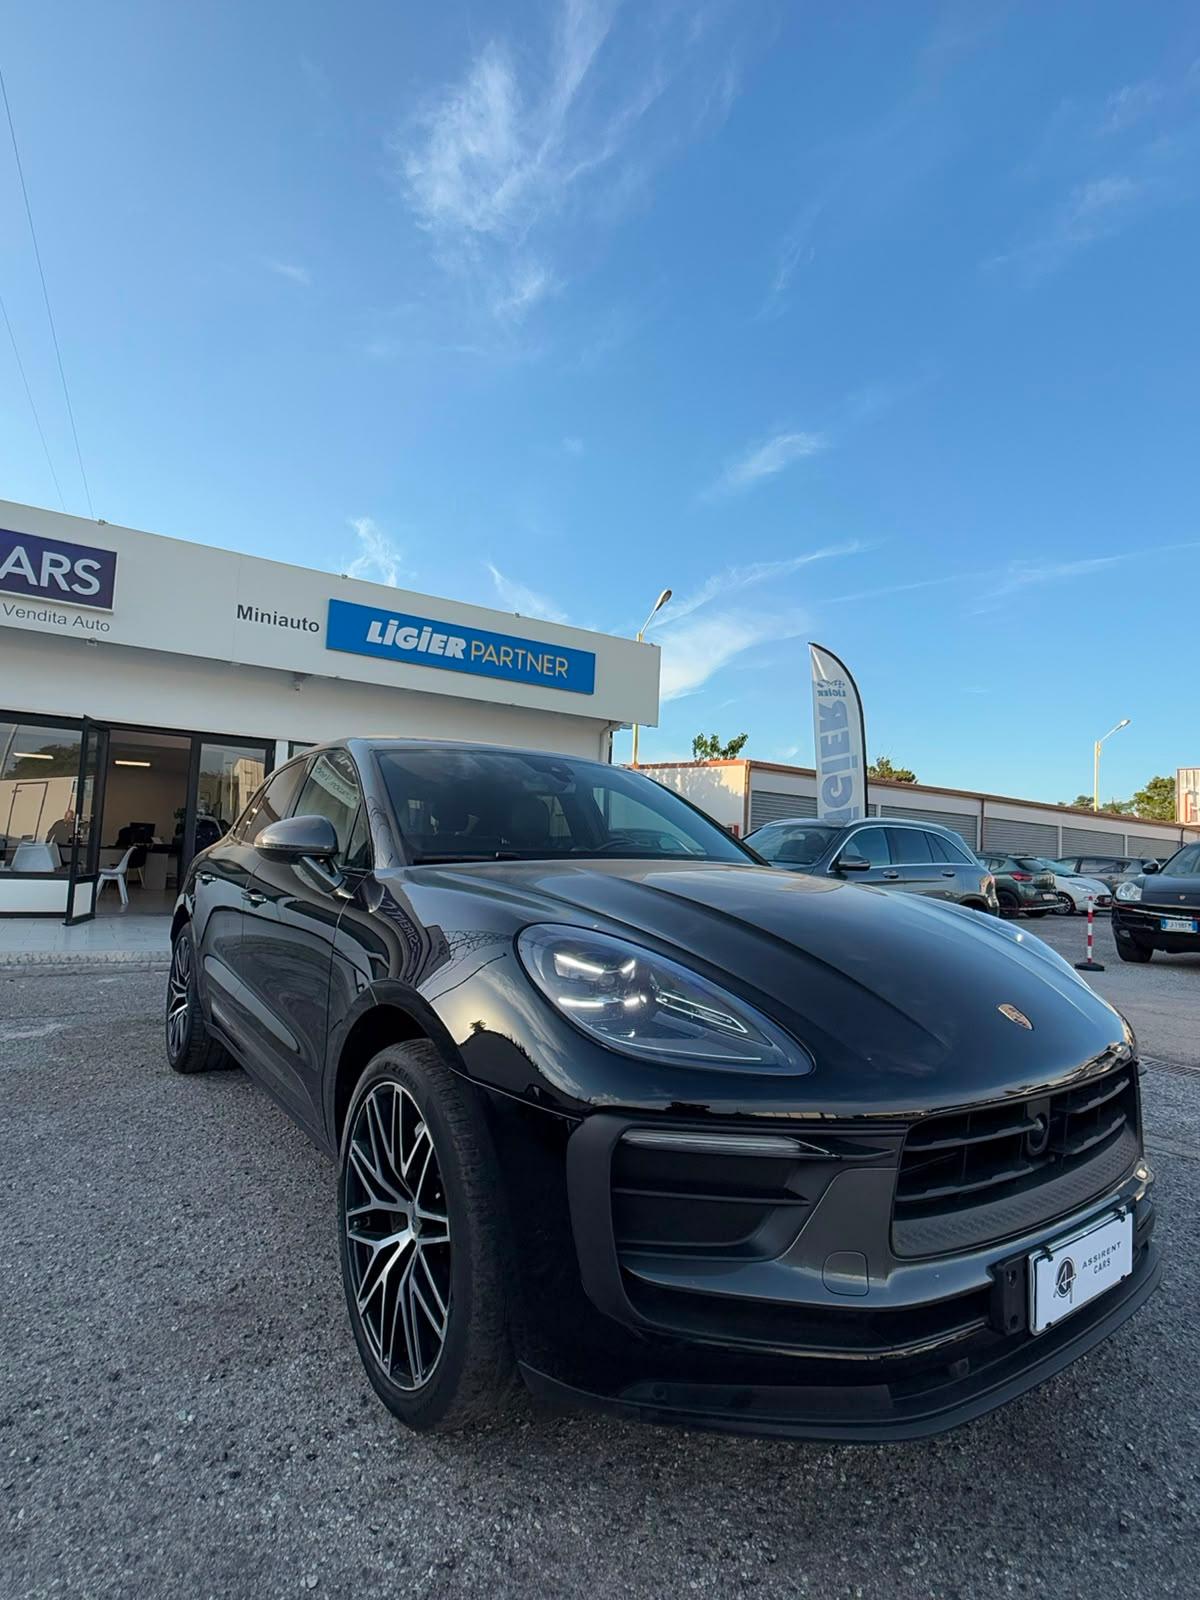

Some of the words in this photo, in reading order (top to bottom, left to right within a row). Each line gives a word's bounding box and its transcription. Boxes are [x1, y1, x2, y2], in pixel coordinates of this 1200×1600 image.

[3, 603, 67, 626] Vendita
[73, 615, 111, 633] Auto
[236, 604, 320, 633] Miniauto
[471, 640, 569, 679] PARTNER
[1082, 1241, 1122, 1270] ASSIRENT
[1093, 1257, 1112, 1275] CARS
